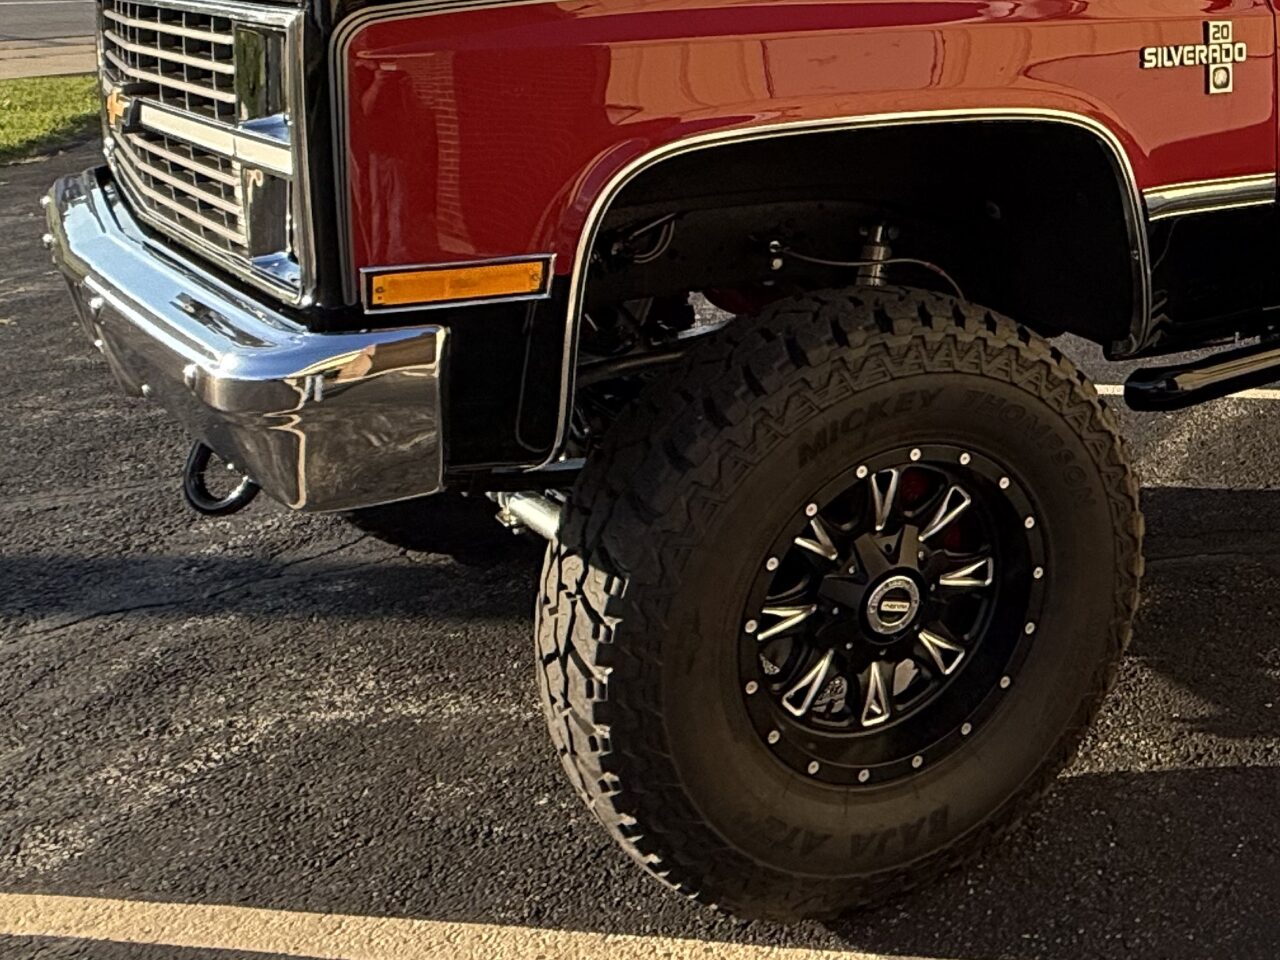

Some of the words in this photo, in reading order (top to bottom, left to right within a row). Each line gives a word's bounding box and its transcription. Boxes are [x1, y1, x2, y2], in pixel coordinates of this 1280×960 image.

[1212, 24, 1230, 40] 20
[1143, 42, 1247, 69] SILVERADO
[796, 386, 943, 468] MICKEY
[962, 388, 1096, 506] THOMPSON
